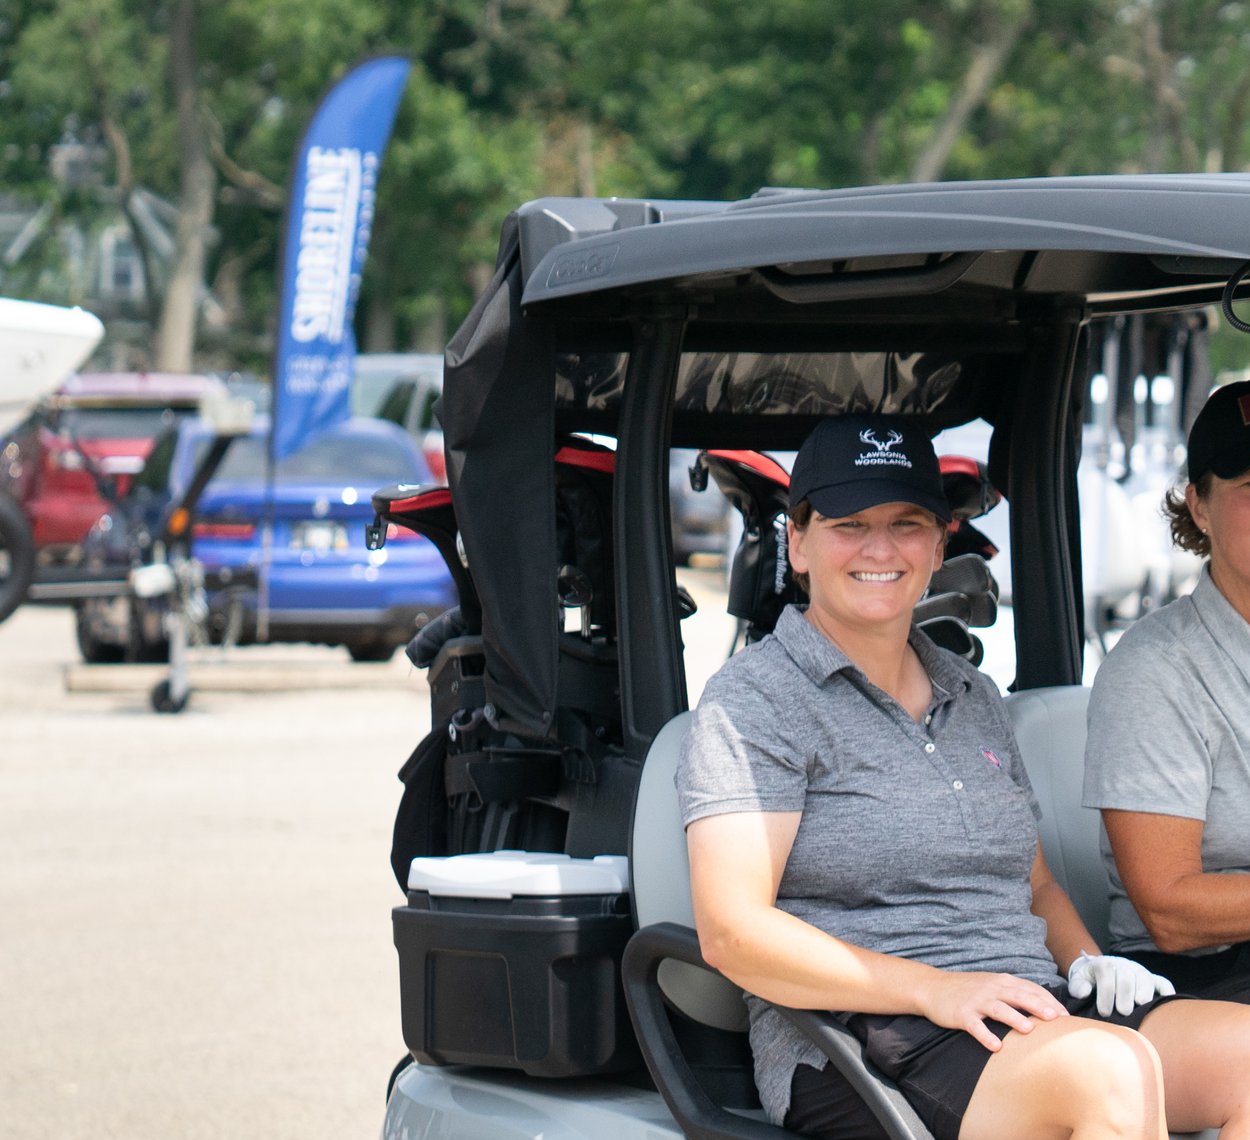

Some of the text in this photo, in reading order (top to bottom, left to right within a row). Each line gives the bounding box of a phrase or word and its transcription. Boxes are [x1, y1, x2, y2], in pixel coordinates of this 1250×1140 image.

[291, 146, 350, 342] SHORELINE
[860, 451, 907, 460] LAWSONIA
[854, 458, 913, 469] WOODLANDS
